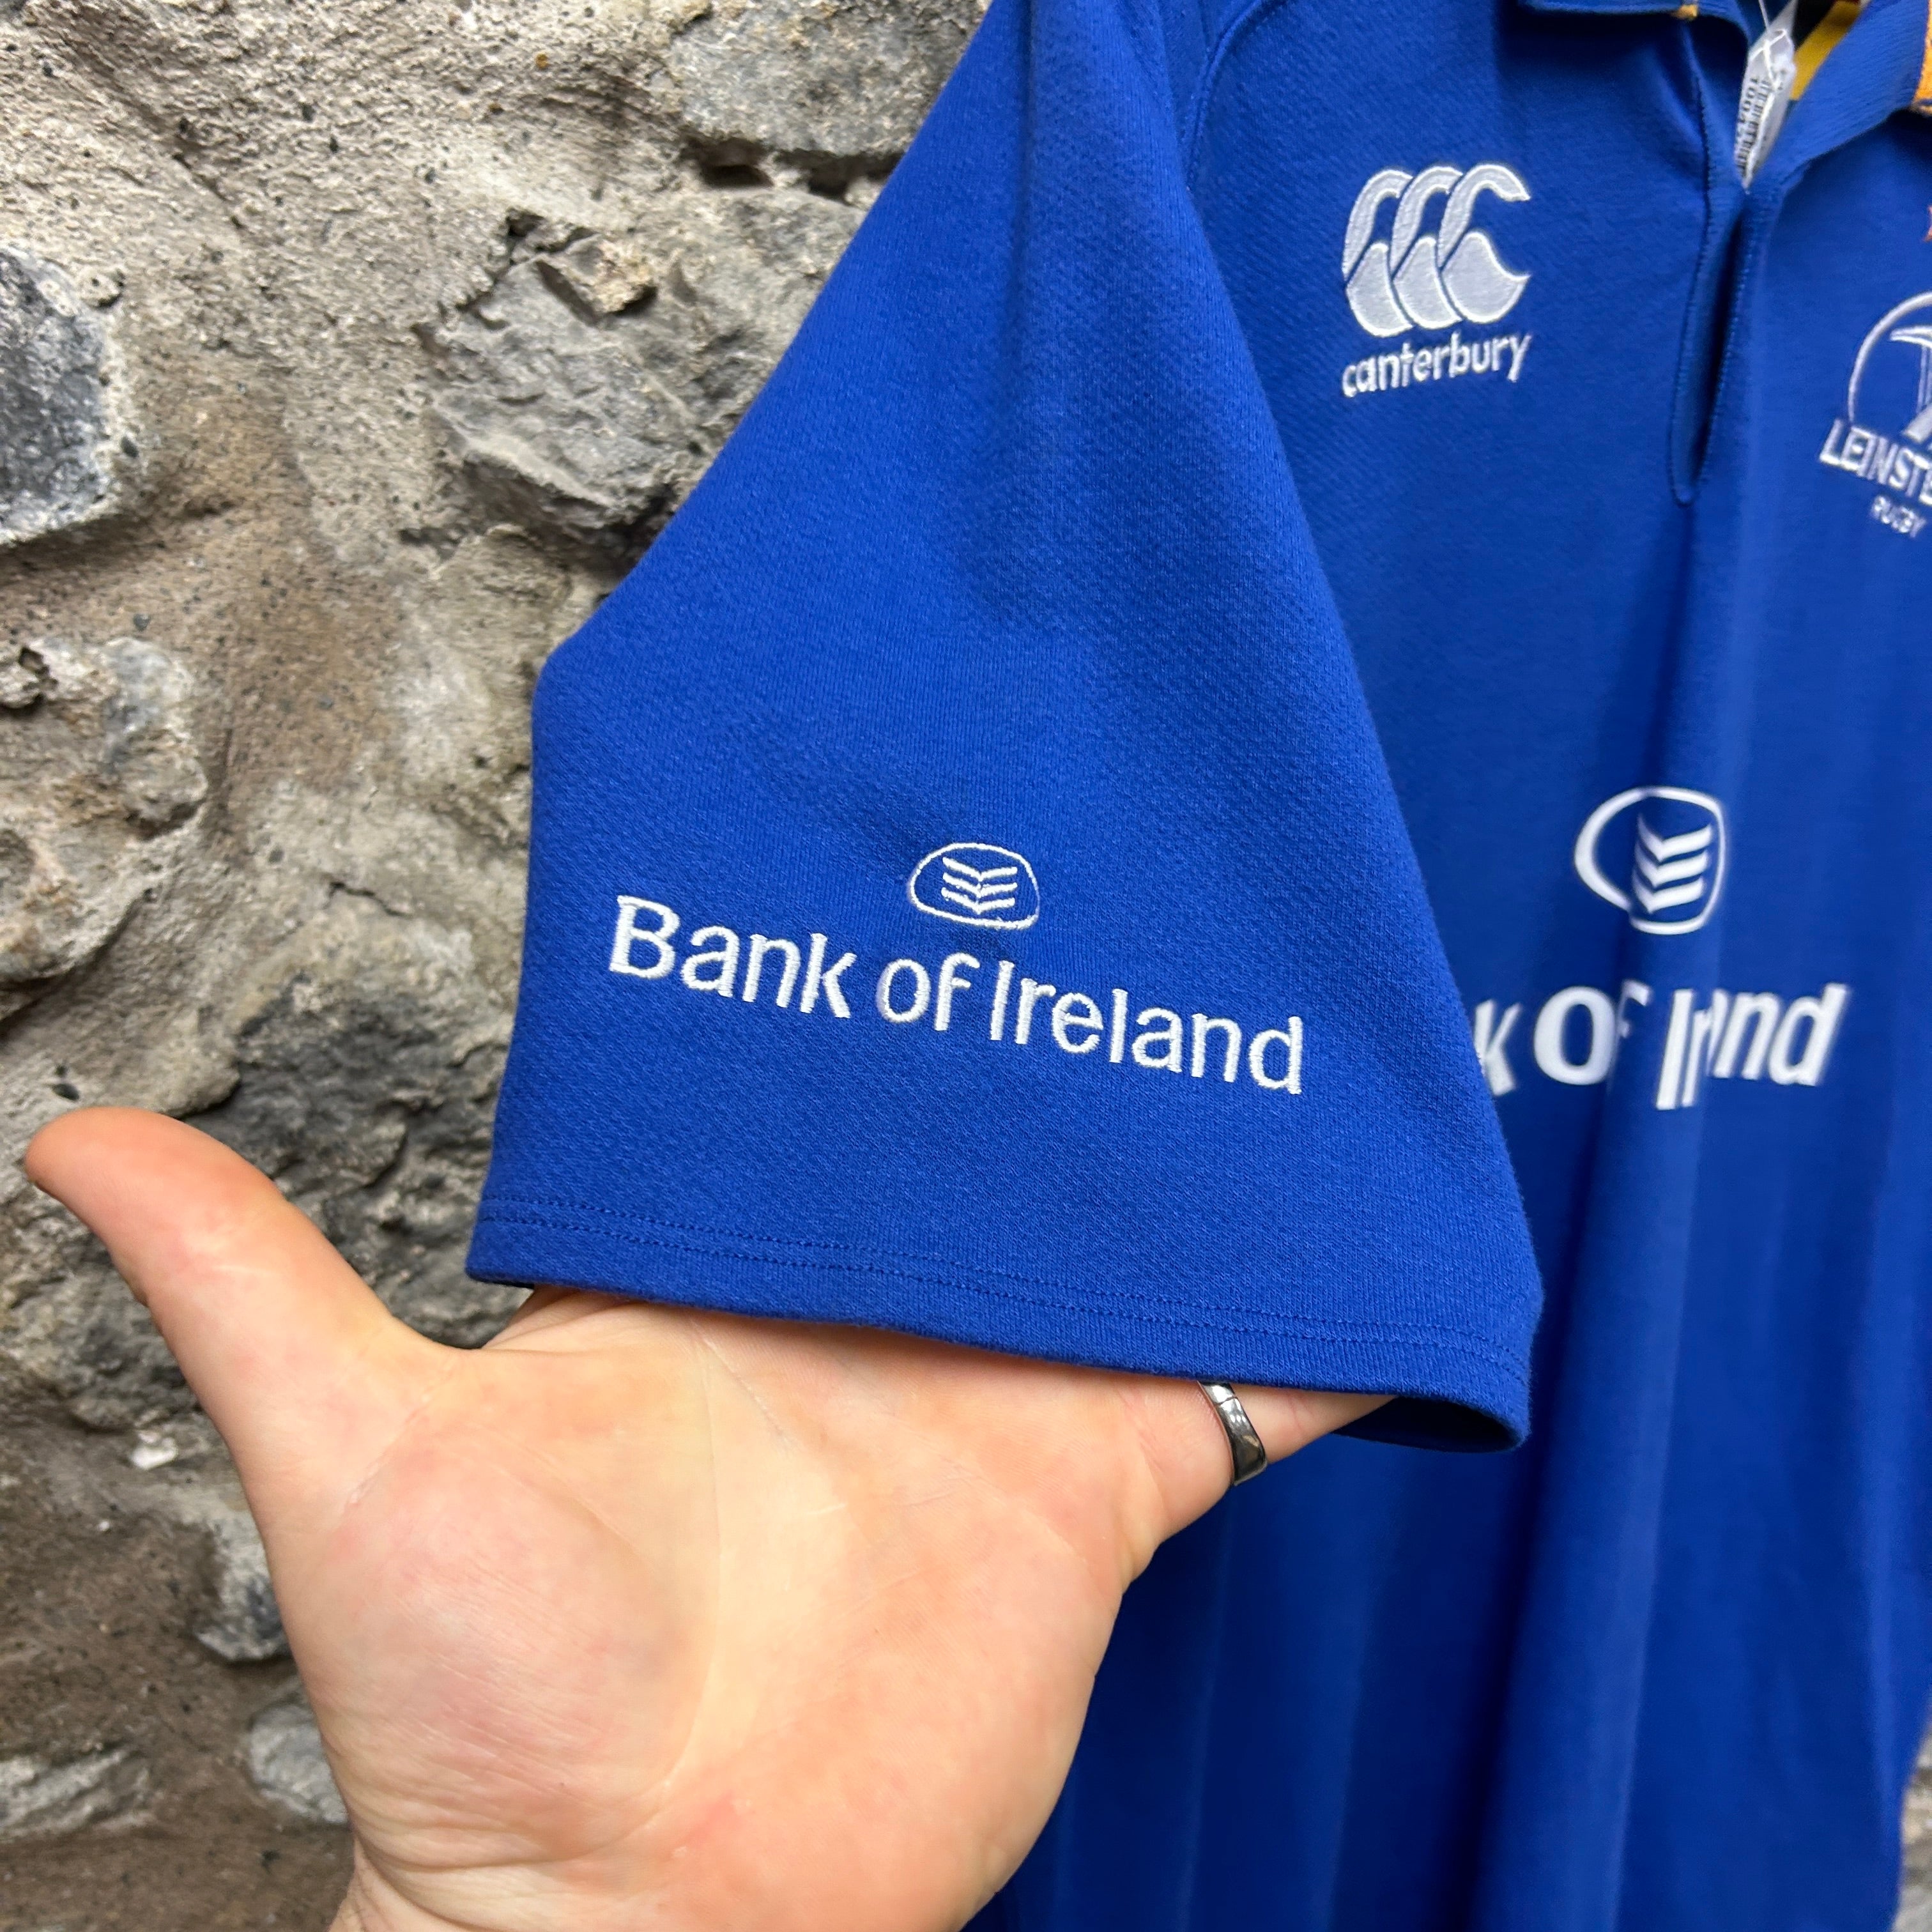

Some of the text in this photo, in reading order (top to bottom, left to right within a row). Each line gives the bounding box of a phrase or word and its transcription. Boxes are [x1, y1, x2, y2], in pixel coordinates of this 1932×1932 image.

[1342, 331, 1531, 397] canterbury
[608, 895, 1303, 1095] Bank of Ireland
